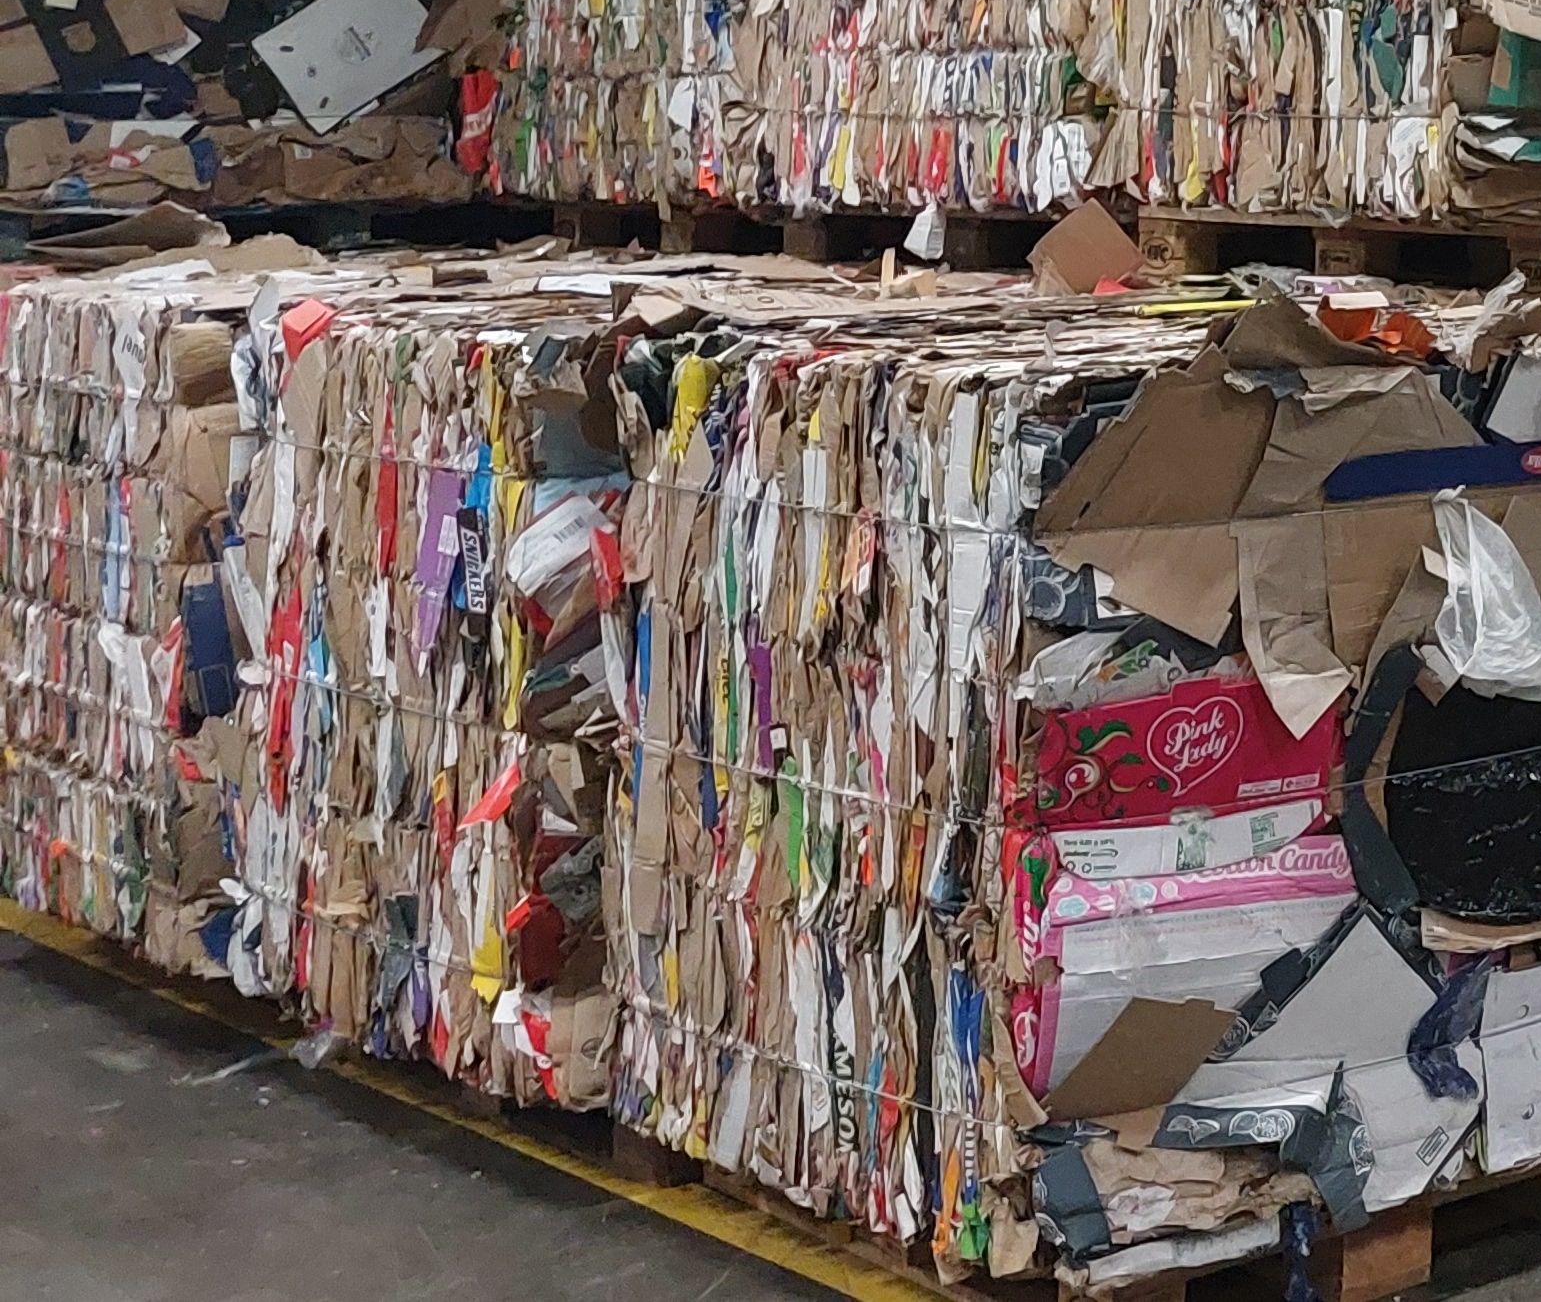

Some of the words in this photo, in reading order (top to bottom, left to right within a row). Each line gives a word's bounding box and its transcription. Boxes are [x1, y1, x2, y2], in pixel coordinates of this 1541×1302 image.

[1163, 704, 1225, 756] Pink
[1174, 732, 1228, 773] Lady
[1279, 844, 1348, 877] Candy
[834, 1036, 857, 1154] AMESON
